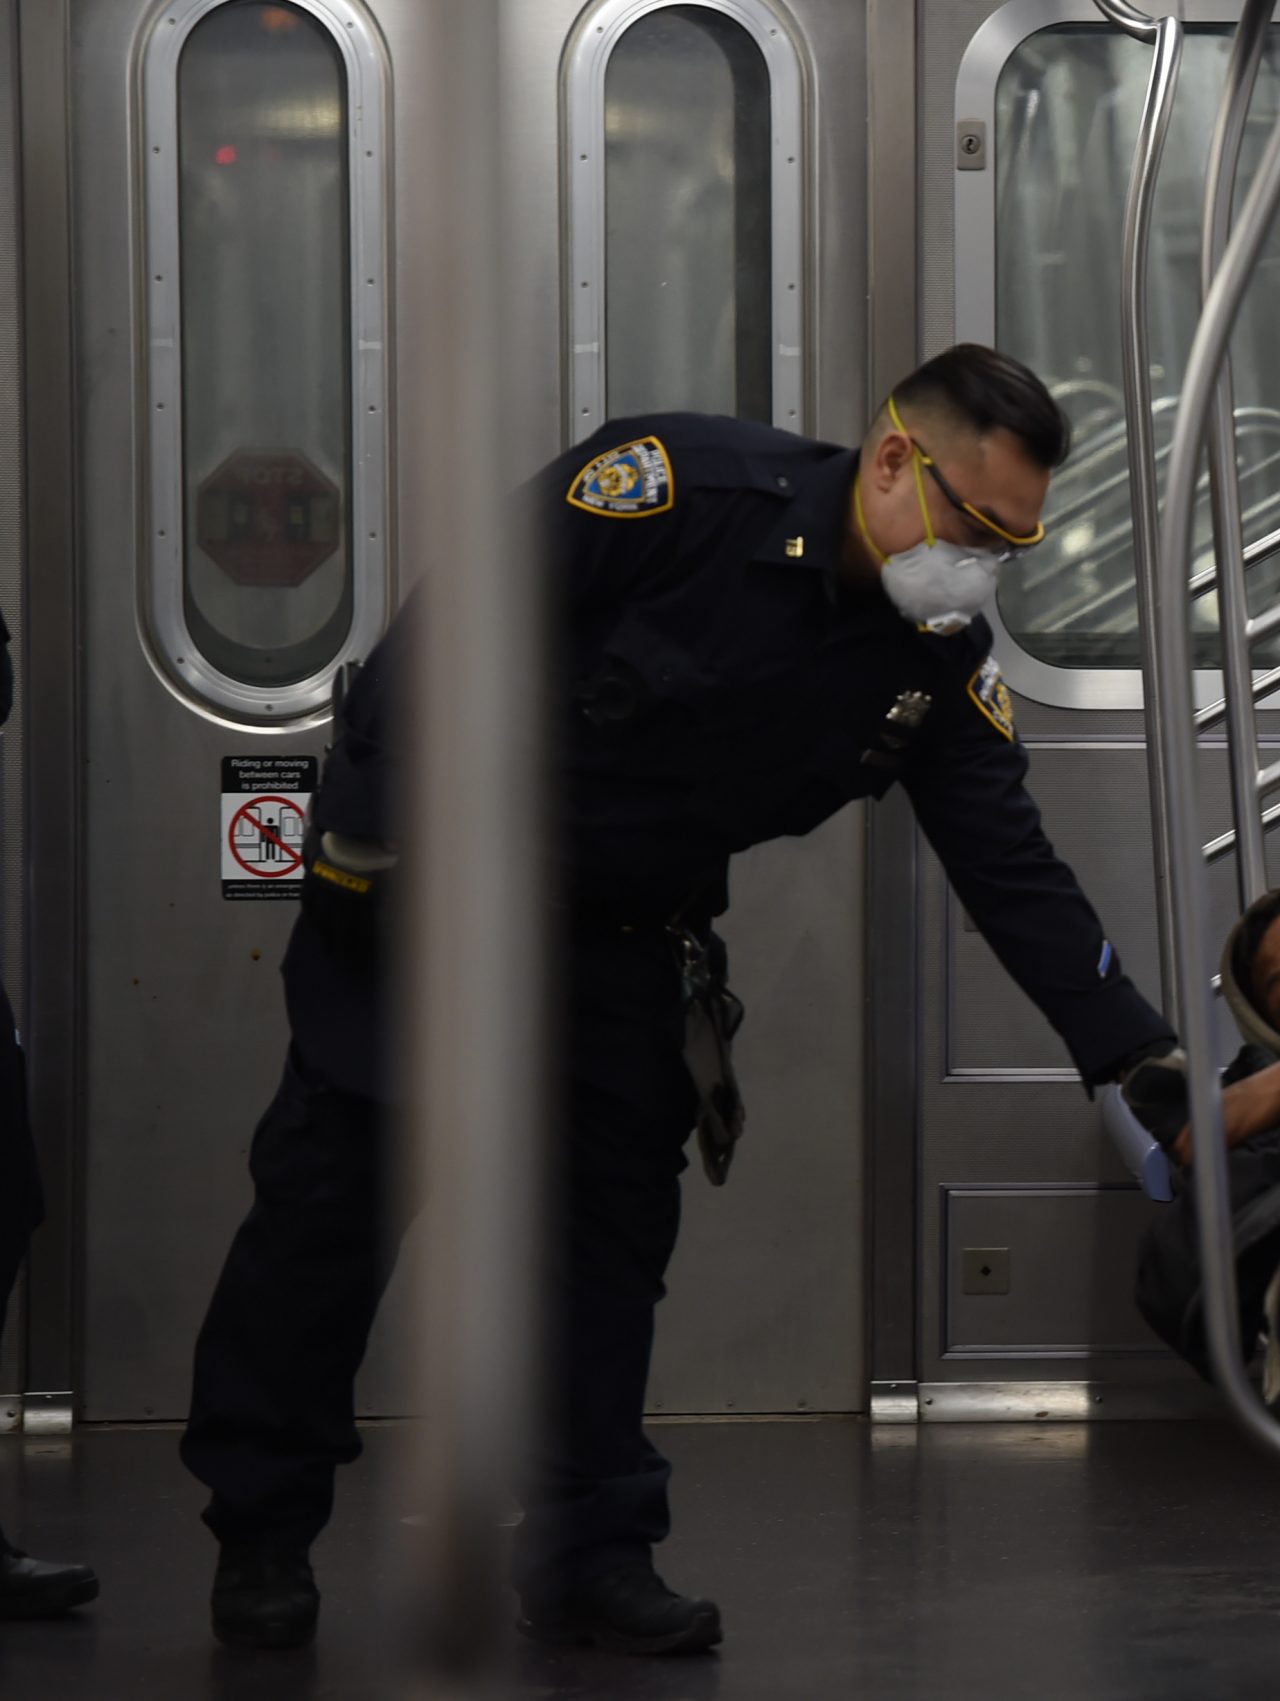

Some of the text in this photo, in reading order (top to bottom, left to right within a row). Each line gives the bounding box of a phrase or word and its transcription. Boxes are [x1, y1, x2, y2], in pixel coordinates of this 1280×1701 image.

[231, 759, 261, 769] Riding
[274, 759, 309, 769] moving
[238, 770, 301, 779] between cars
[241, 781, 299, 791] is prohibited
